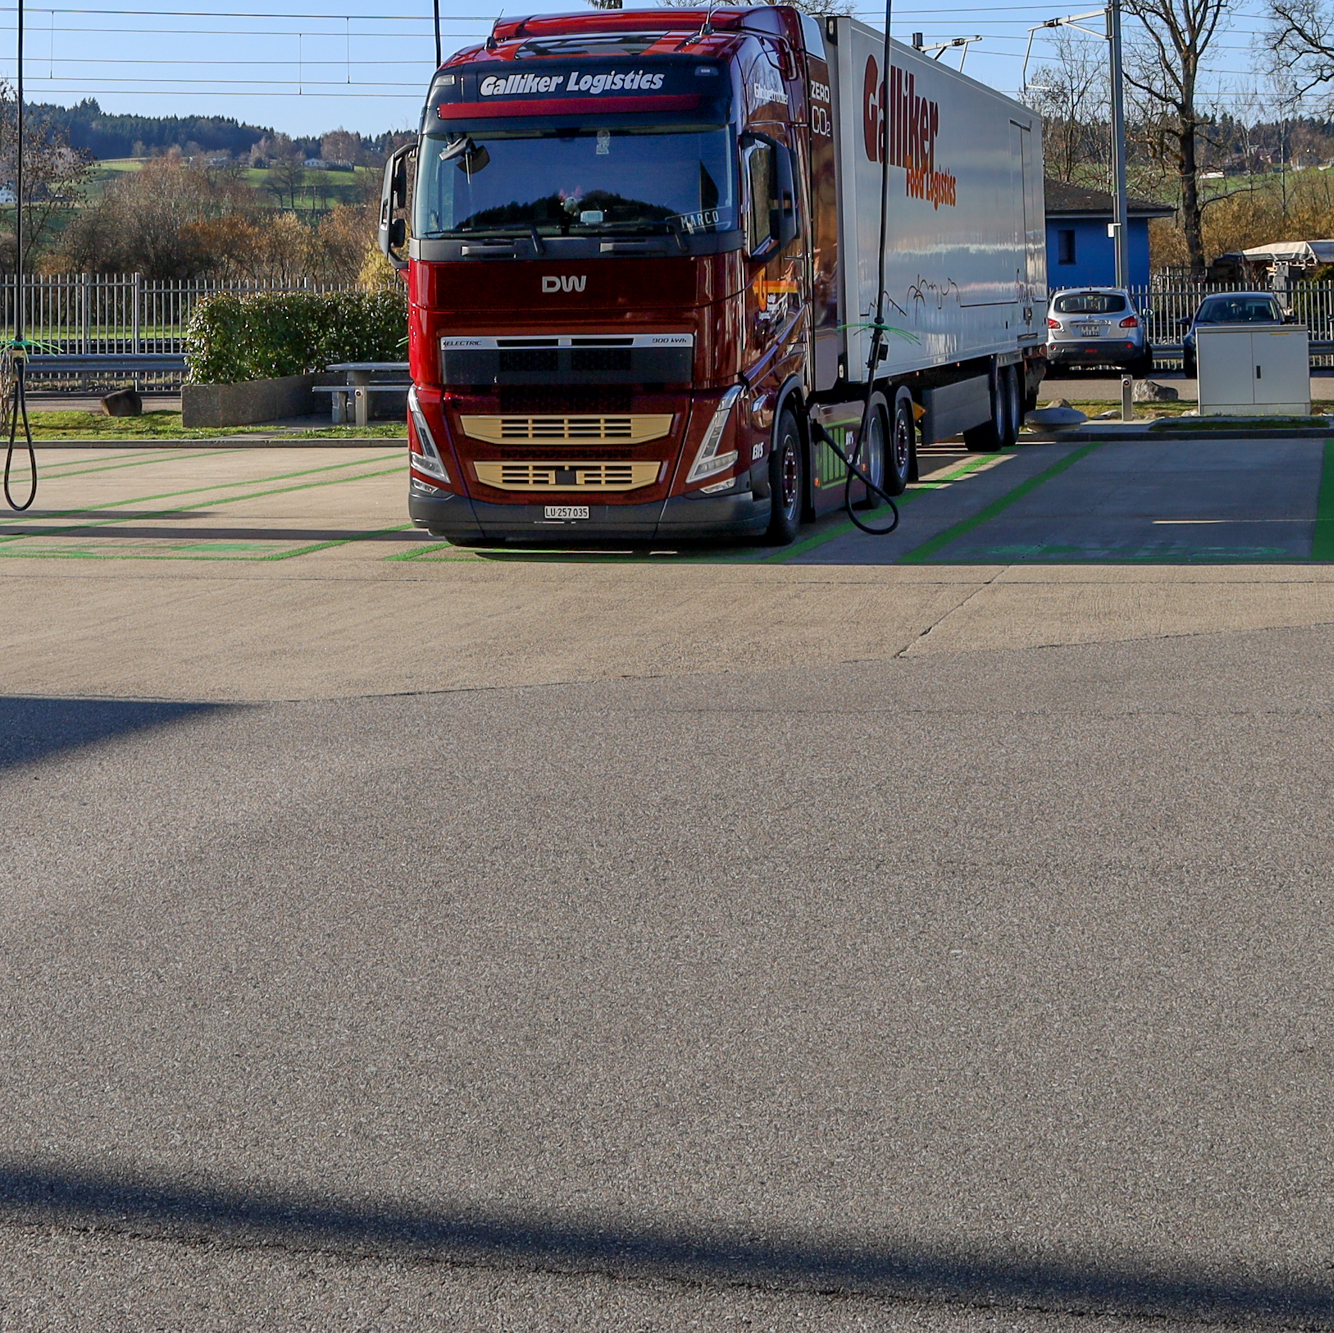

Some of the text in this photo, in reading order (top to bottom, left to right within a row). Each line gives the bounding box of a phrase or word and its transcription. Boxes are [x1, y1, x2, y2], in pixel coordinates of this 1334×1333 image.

[479, 69, 666, 97] Galliker Logistics
[810, 79, 831, 104] ZERO
[680, 210, 720, 229] MARCO
[541, 275, 587, 293] DW
